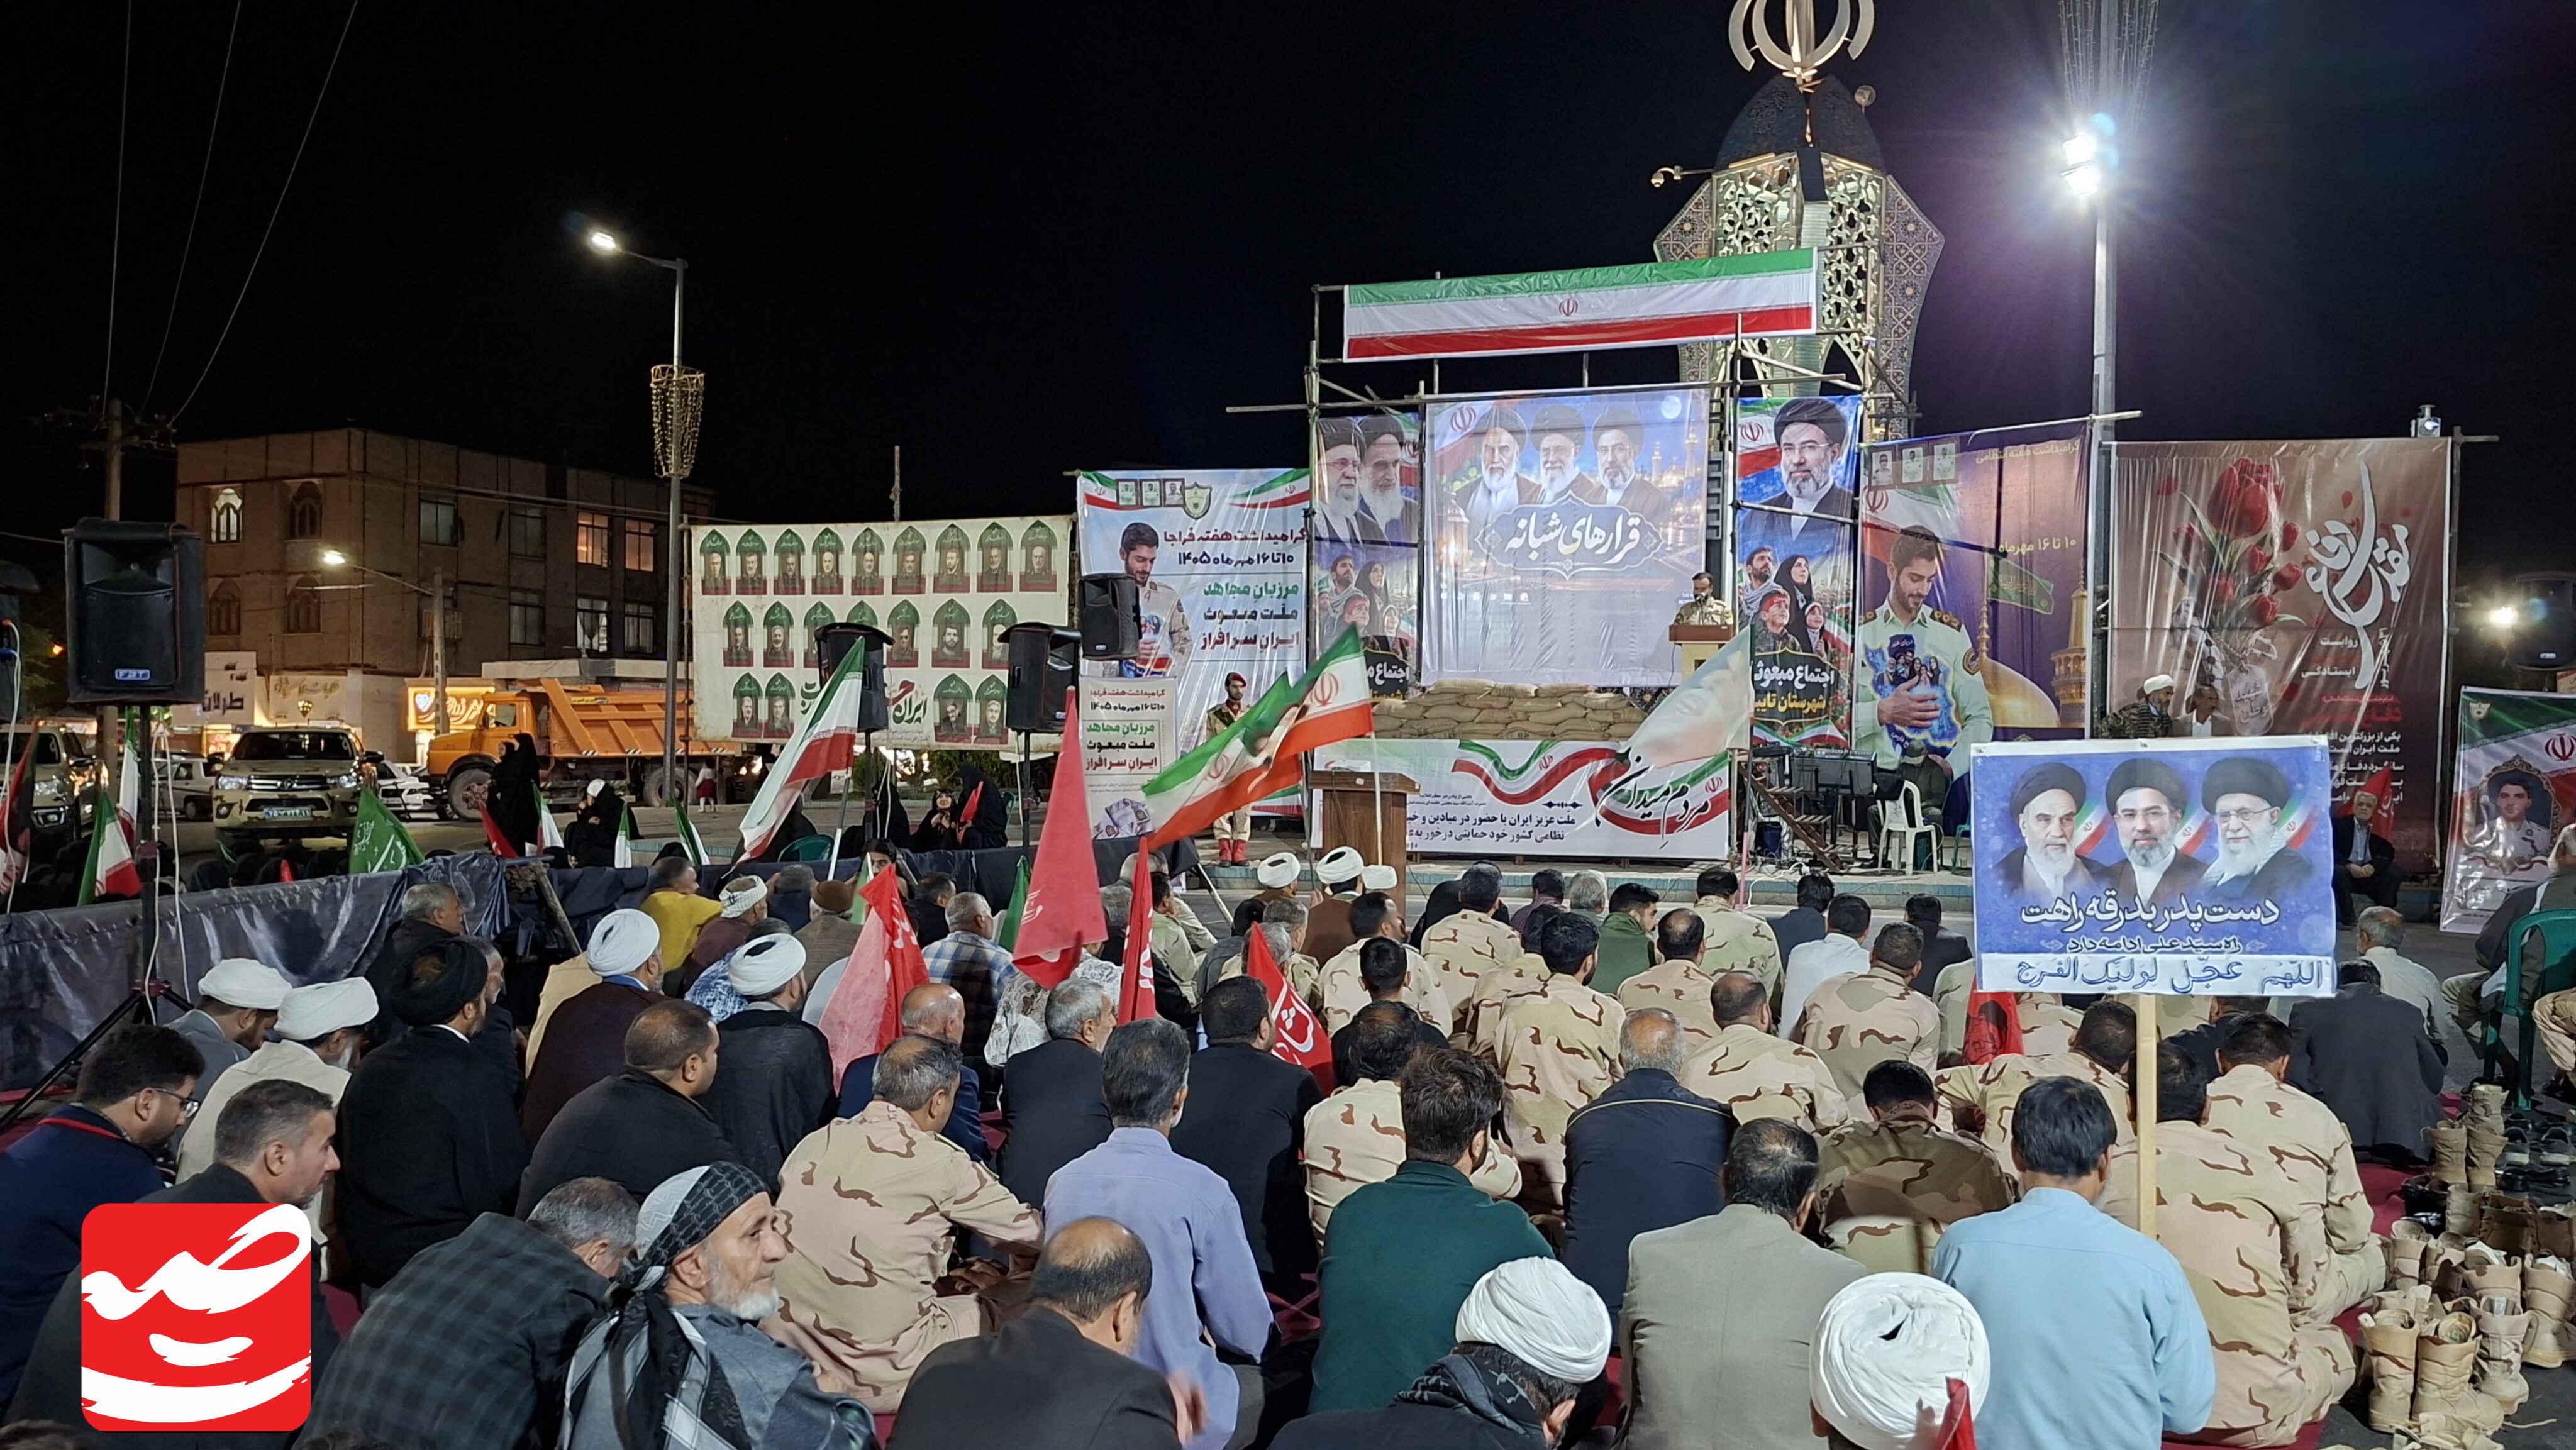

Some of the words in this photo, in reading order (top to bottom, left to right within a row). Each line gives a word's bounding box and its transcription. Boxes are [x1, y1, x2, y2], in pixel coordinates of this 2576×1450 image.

[1163, 527, 1196, 546] فراجا
[1197, 529, 1233, 541] هفته
[1234, 527, 1307, 544] گرامیداشت
[1504, 511, 1563, 561] شبانه
[1558, 513, 1641, 564] قرارهای
[2052, 538, 2061, 549] تا
[1178, 551, 1211, 565] ۱۴۰۵
[1203, 582, 1251, 599] مجاهد
[1203, 607, 1258, 624] مبعوث
[2320, 636, 2358, 648] روایت
[1375, 661, 1409, 685] اجتماع
[1794, 664, 1835, 689] اجتماع
[2301, 666, 2355, 678] ایستادگی
[1091, 701, 1112, 711] ۱۴۰۵
[1754, 692, 1777, 712] تایب
[1778, 692, 1826, 714] شهرستان
[1086, 722, 1120, 734] مجاهد
[2375, 732, 2383, 741] از
[2384, 731, 2401, 742] یکی
[1086, 739, 1126, 753] مبعوث
[2353, 744, 2375, 755] ایران
[2378, 744, 2400, 753] ملت
[1421, 816, 1426, 825] و
[1428, 812, 1457, 825] میادین
[1460, 816, 1470, 826] در
[1472, 812, 1499, 827] حضور
[1501, 813, 1507, 825] با
[1509, 813, 1533, 827] ایران
[1535, 815, 1555, 827] عزیز
[1454, 827, 1487, 843] حمایتی
[1489, 830, 1507, 841] خود
[1509, 829, 1534, 843] کشور
[1535, 829, 1565, 843] نظامی
[2020, 892, 2085, 933] راهت
[2085, 888, 2157, 933] بدرقه
[2153, 893, 2203, 933] پدر
[2203, 898, 2281, 926] دست
[2067, 935, 2099, 953] دارد
[2099, 935, 2143, 952] ادامه
[2221, 935, 2242, 954] راه
